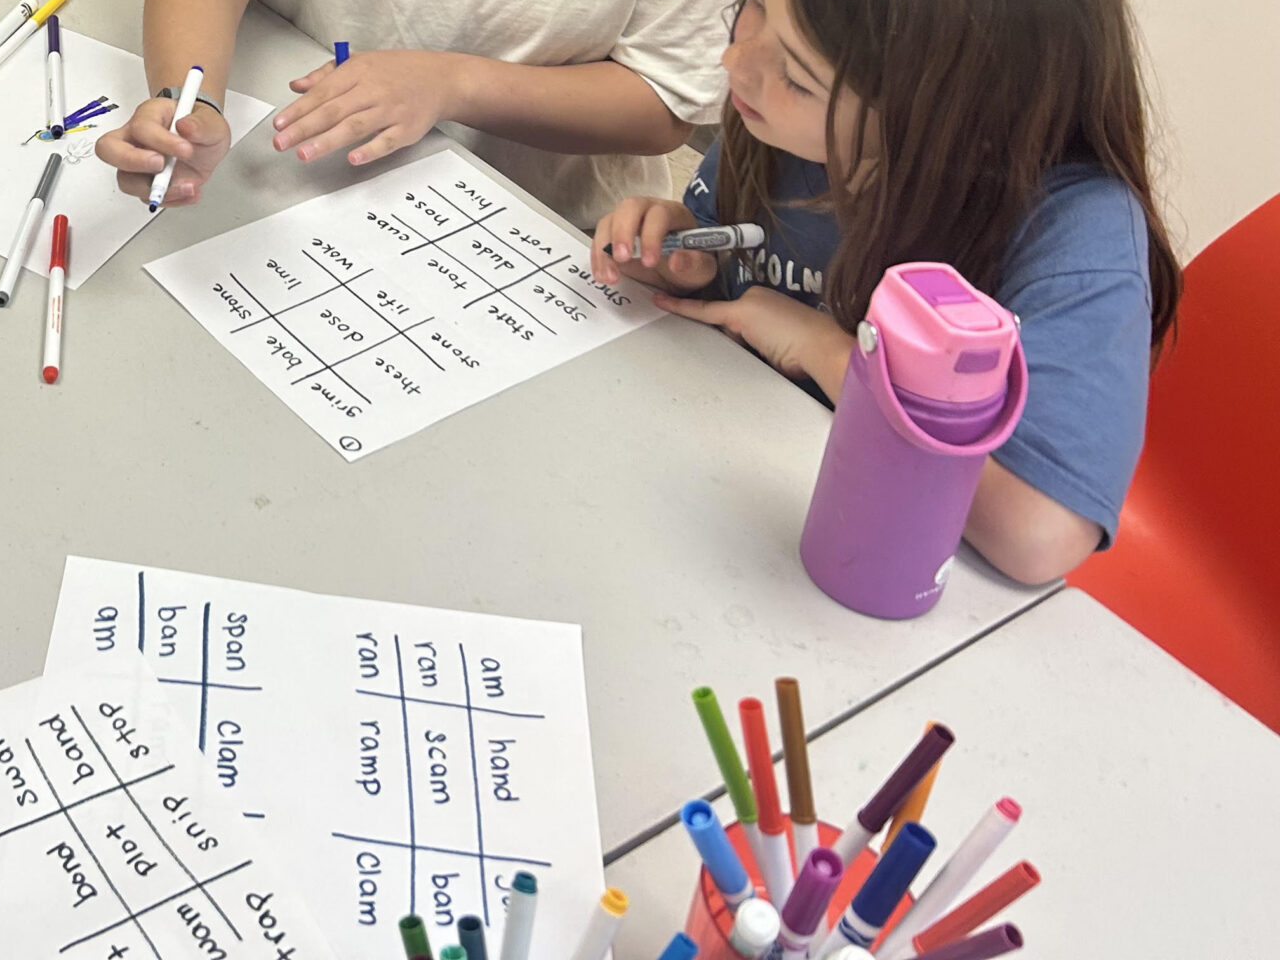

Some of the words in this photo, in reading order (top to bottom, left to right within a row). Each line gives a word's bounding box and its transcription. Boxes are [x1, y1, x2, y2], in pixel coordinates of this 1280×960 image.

[405, 192, 450, 227] hose
[454, 180, 493, 211] hive
[366, 211, 410, 242] cube
[508, 227, 553, 255] vote
[311, 237, 354, 271] woke
[471, 239, 516, 271] dude
[266, 258, 303, 291] lime
[427, 258, 468, 290] tone
[212, 282, 252, 320] stone
[376, 289, 410, 316] life
[532, 282, 591, 322] spoke
[319, 308, 364, 342] dose
[487, 304, 535, 341] state
[266, 335, 303, 371] bake
[430, 332, 480, 369] stone
[374, 357, 422, 395] these
[310, 382, 364, 418] grime
[92, 605, 119, 652] am
[157, 605, 188, 658] ban
[221, 612, 249, 672] span
[355, 632, 380, 679] ran
[413, 641, 438, 688] ran
[480, 657, 505, 699] am
[38, 713, 95, 786] band
[98, 702, 150, 760] stop
[354, 720, 382, 797] ramp
[424, 729, 451, 805] scam
[487, 739, 520, 802] hand
[162, 796, 219, 852] snip
[105, 823, 159, 878] plot
[45, 841, 99, 909] bond
[430, 872, 461, 927] ban
